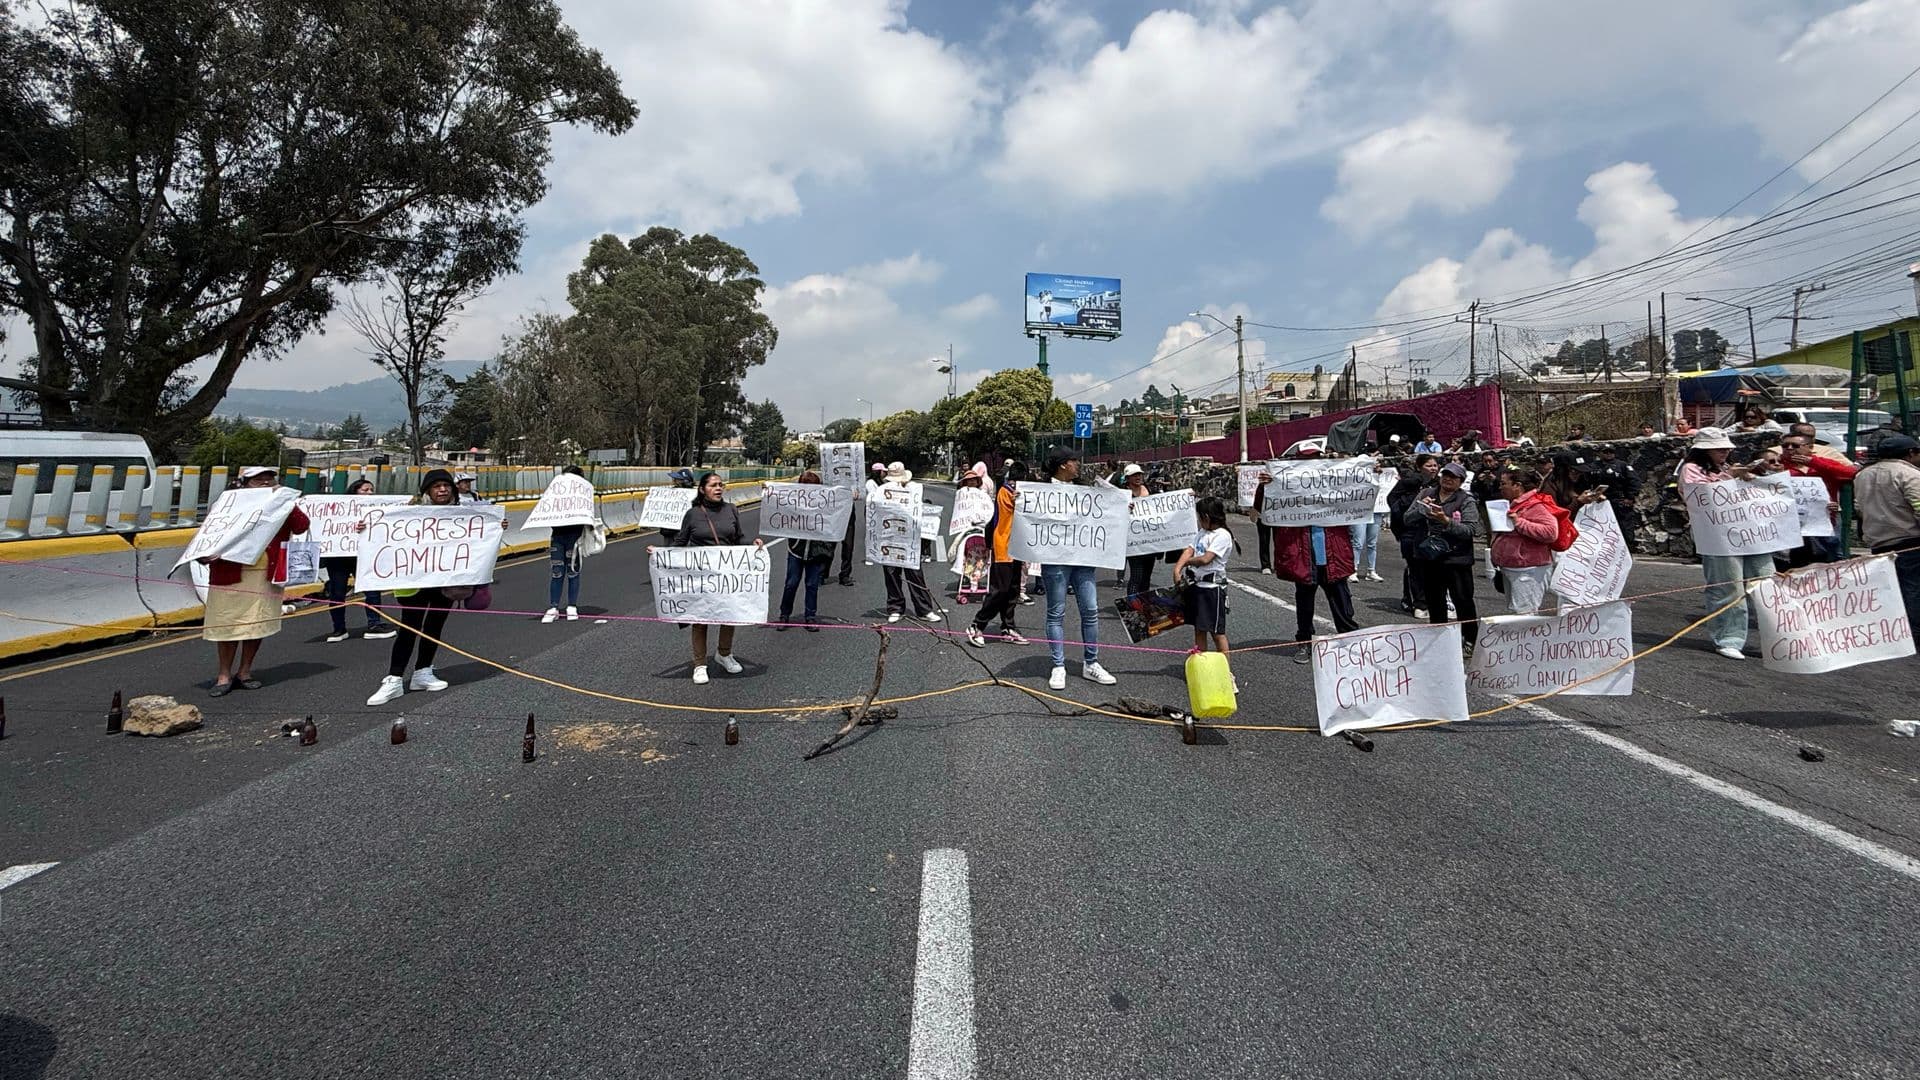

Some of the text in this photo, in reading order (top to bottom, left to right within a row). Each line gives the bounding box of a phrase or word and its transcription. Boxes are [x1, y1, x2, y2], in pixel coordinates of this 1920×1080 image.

[1275, 466, 1294, 490] TE
[1300, 466, 1373, 489] QUEREMOS
[766, 485, 836, 511] REGRESA
[1022, 490, 1104, 519] EXIGIMOS
[1264, 495, 1324, 511] DEVUELTA
[1328, 488, 1375, 505] CAMILA
[1686, 486, 1709, 507] TE
[1767, 482, 1788, 496] DE
[362, 509, 484, 545] REGRESA
[769, 512, 824, 531] CAMILA
[1130, 516, 1167, 535] CASA
[1705, 507, 1747, 525] VUELTA
[1026, 523, 1107, 552] JUSTICIA
[1727, 522, 1778, 548] CAMILA
[373, 543, 470, 579] CAMILA
[656, 547, 766, 572] NI UNA MAS
[658, 575, 676, 595] EN
[681, 574, 696, 594] LA
[1825, 567, 1848, 591] DE
[1846, 563, 1869, 587] TU
[660, 598, 688, 614] CAS
[1803, 593, 1838, 626] PARA
[1844, 588, 1882, 617] QUE
[1558, 612, 1600, 635] APOYO
[1313, 631, 1418, 675] REGRESA
[1484, 637, 1629, 669] DE LAS AUTORIDADES
[1336, 665, 1412, 709] CAMILA
[1467, 664, 1578, 690] REGRESA CAMILA
